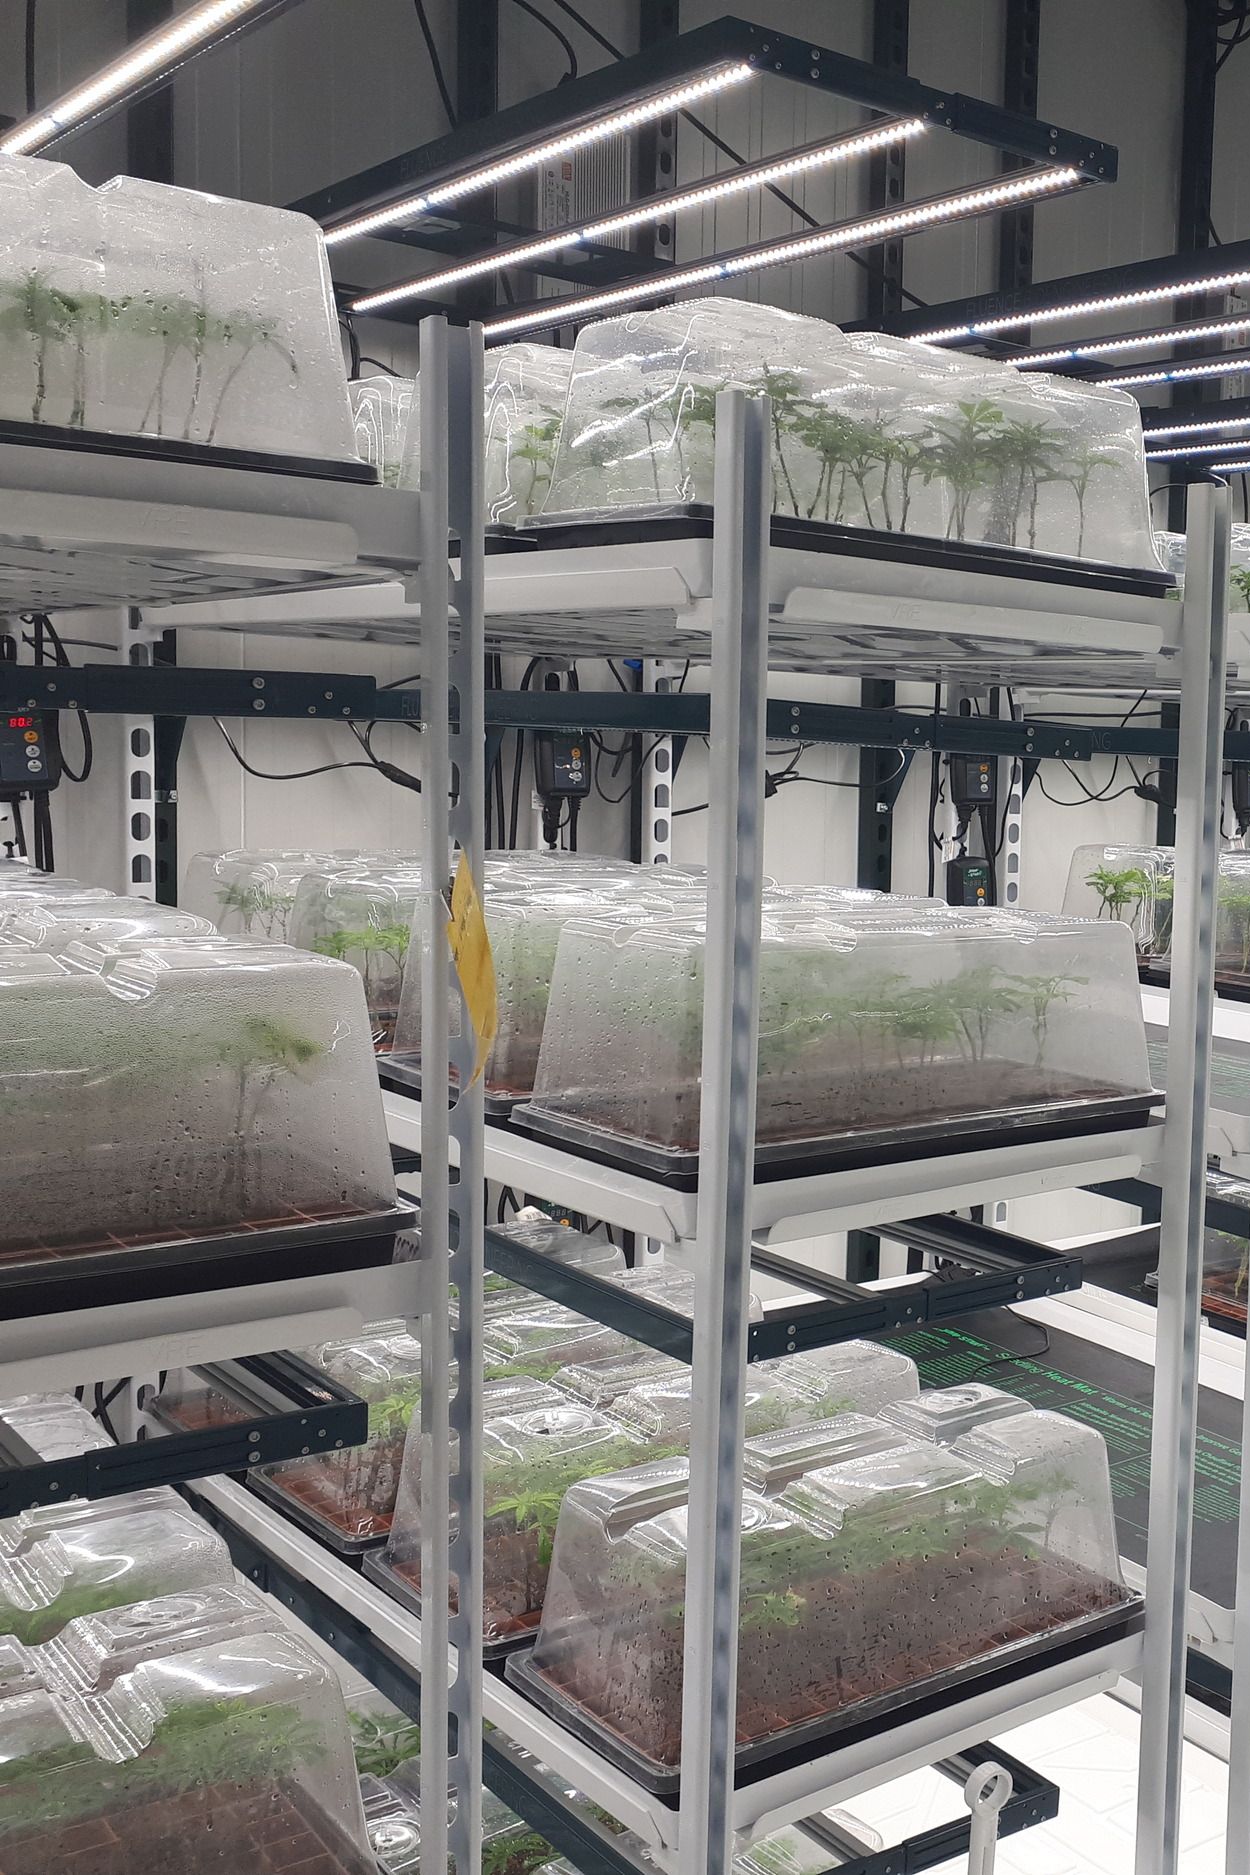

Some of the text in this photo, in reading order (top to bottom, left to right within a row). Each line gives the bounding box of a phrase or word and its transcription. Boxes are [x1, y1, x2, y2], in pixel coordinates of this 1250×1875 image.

[966, 291, 1021, 318] FLUENCE
[1043, 1369, 1073, 1385] Heat
[1073, 1379, 1099, 1395] Mat
